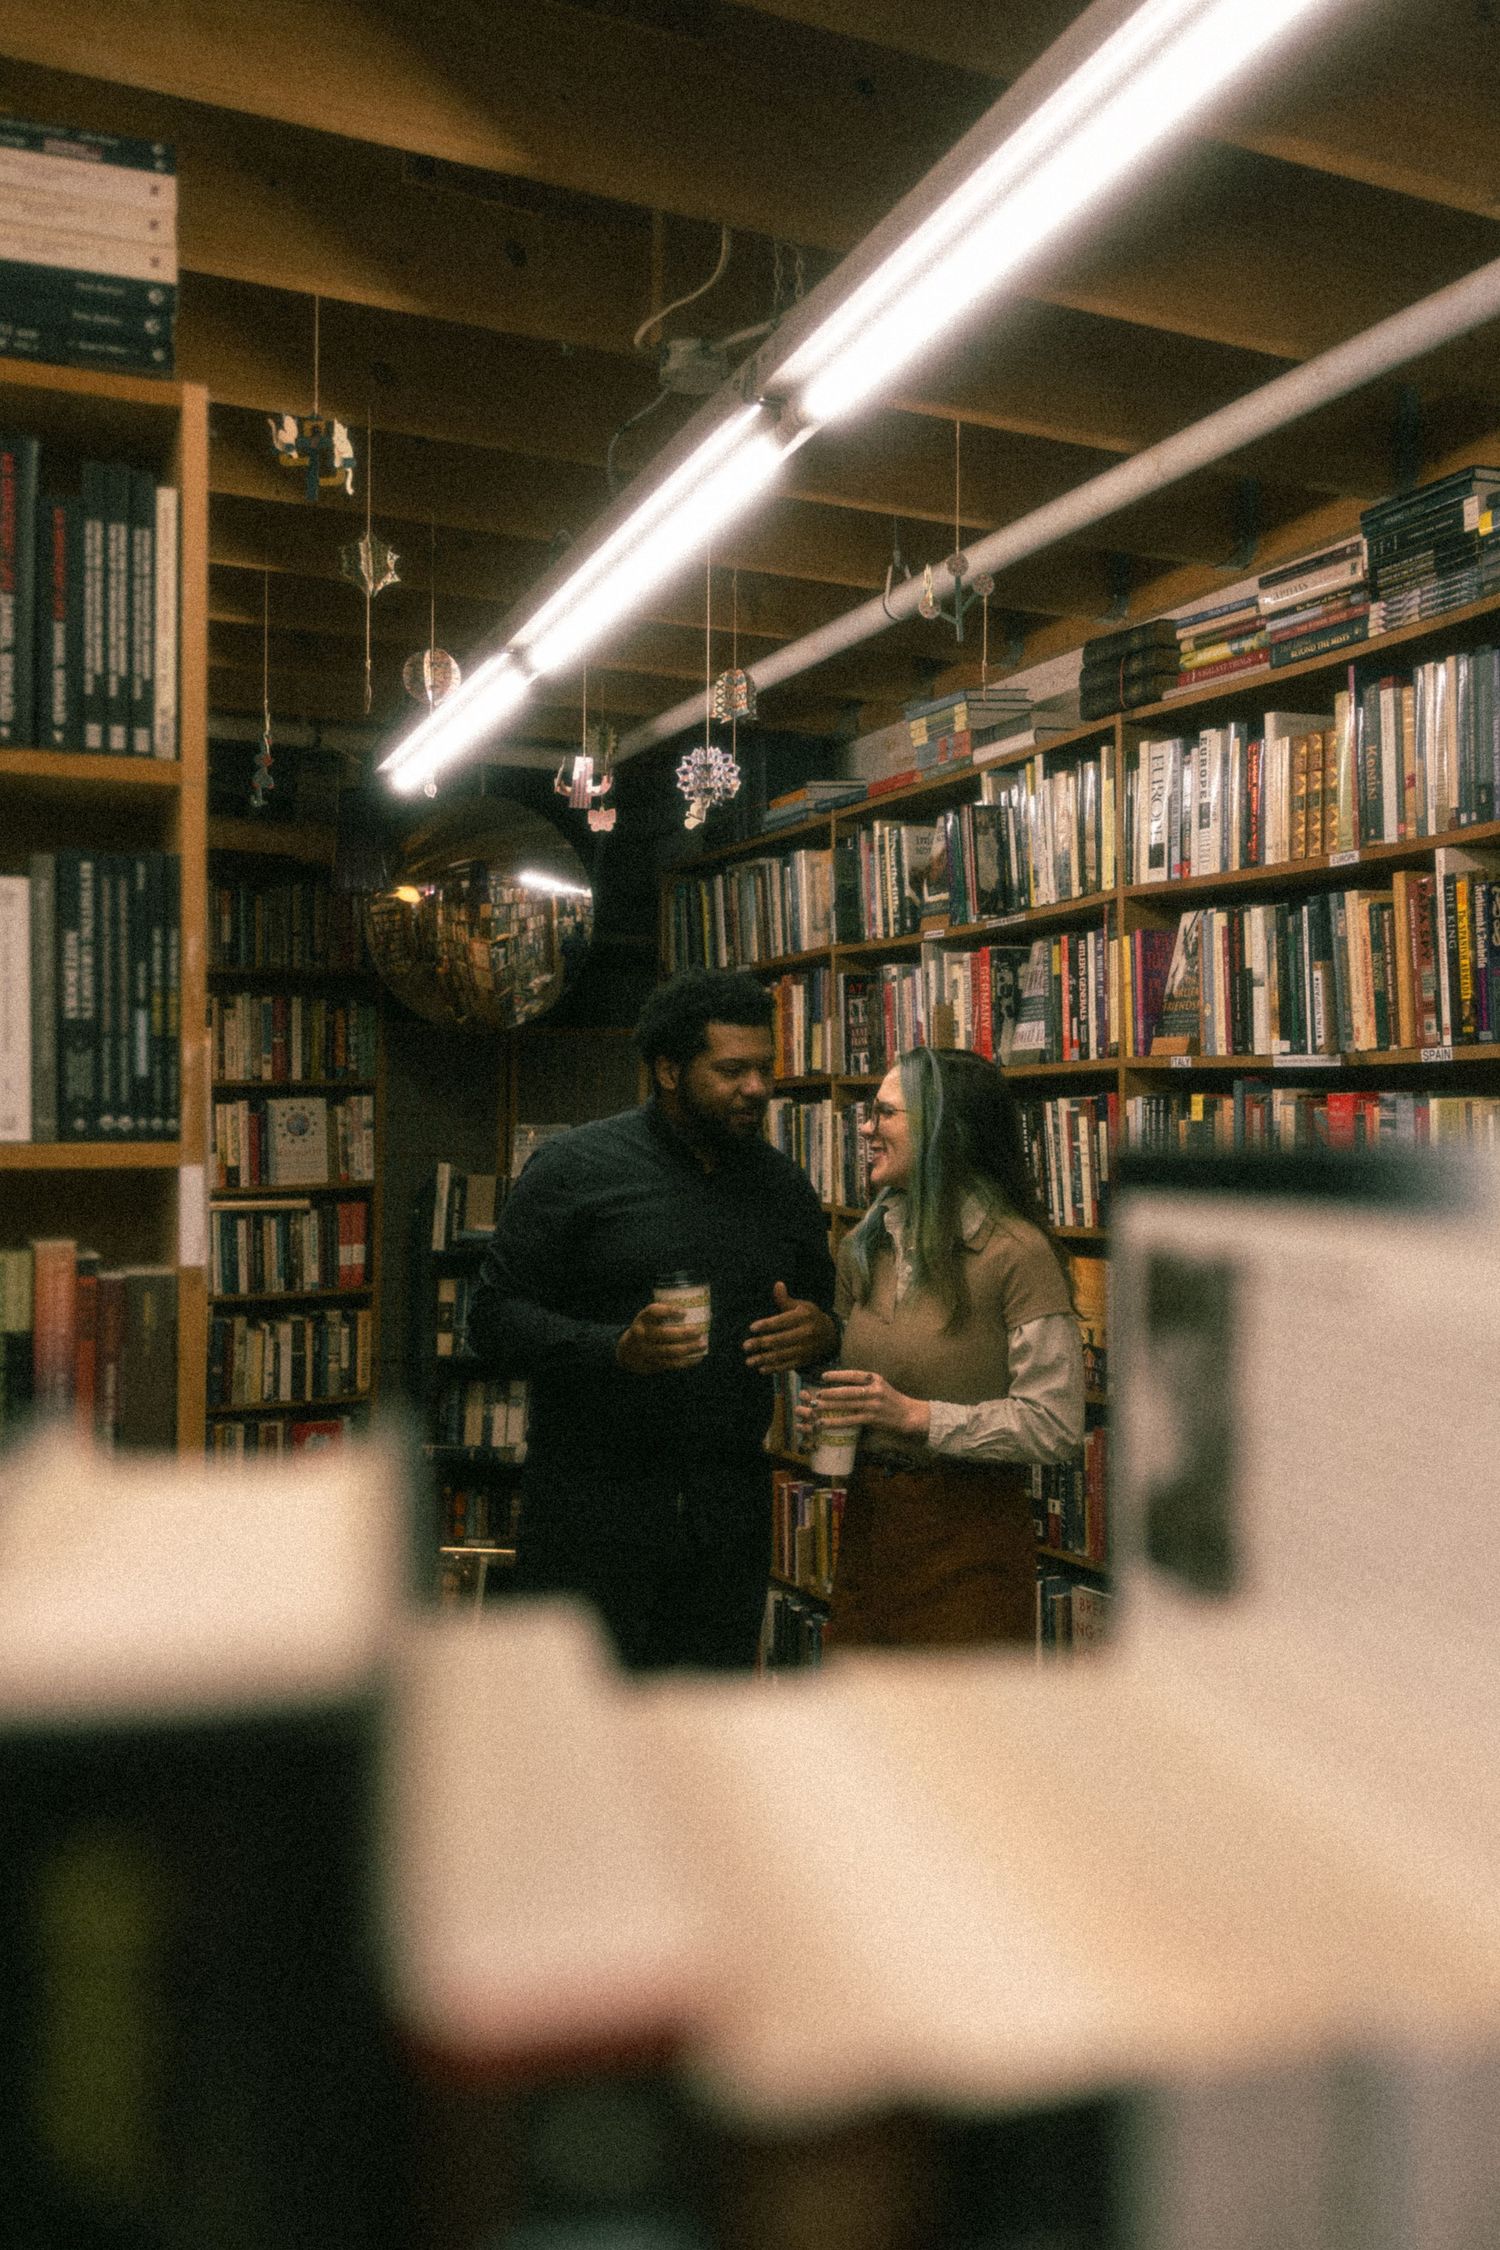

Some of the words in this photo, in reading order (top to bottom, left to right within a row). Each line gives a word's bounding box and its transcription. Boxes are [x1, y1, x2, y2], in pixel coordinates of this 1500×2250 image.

[1199, 737, 1208, 799] EUROPE
[1151, 754, 1165, 839] EUROPE
[1332, 853, 1356, 865] EUROPE
[1445, 885, 1454, 909] THE
[1447, 915, 1457, 950] KING
[1078, 939, 1087, 977] HITLER'S
[980, 966, 990, 1028] GERMANY
[1079, 977, 1087, 1021] GENERALS
[1172, 1057, 1191, 1067] ITALY
[1422, 1049, 1452, 1061] SPAIN
